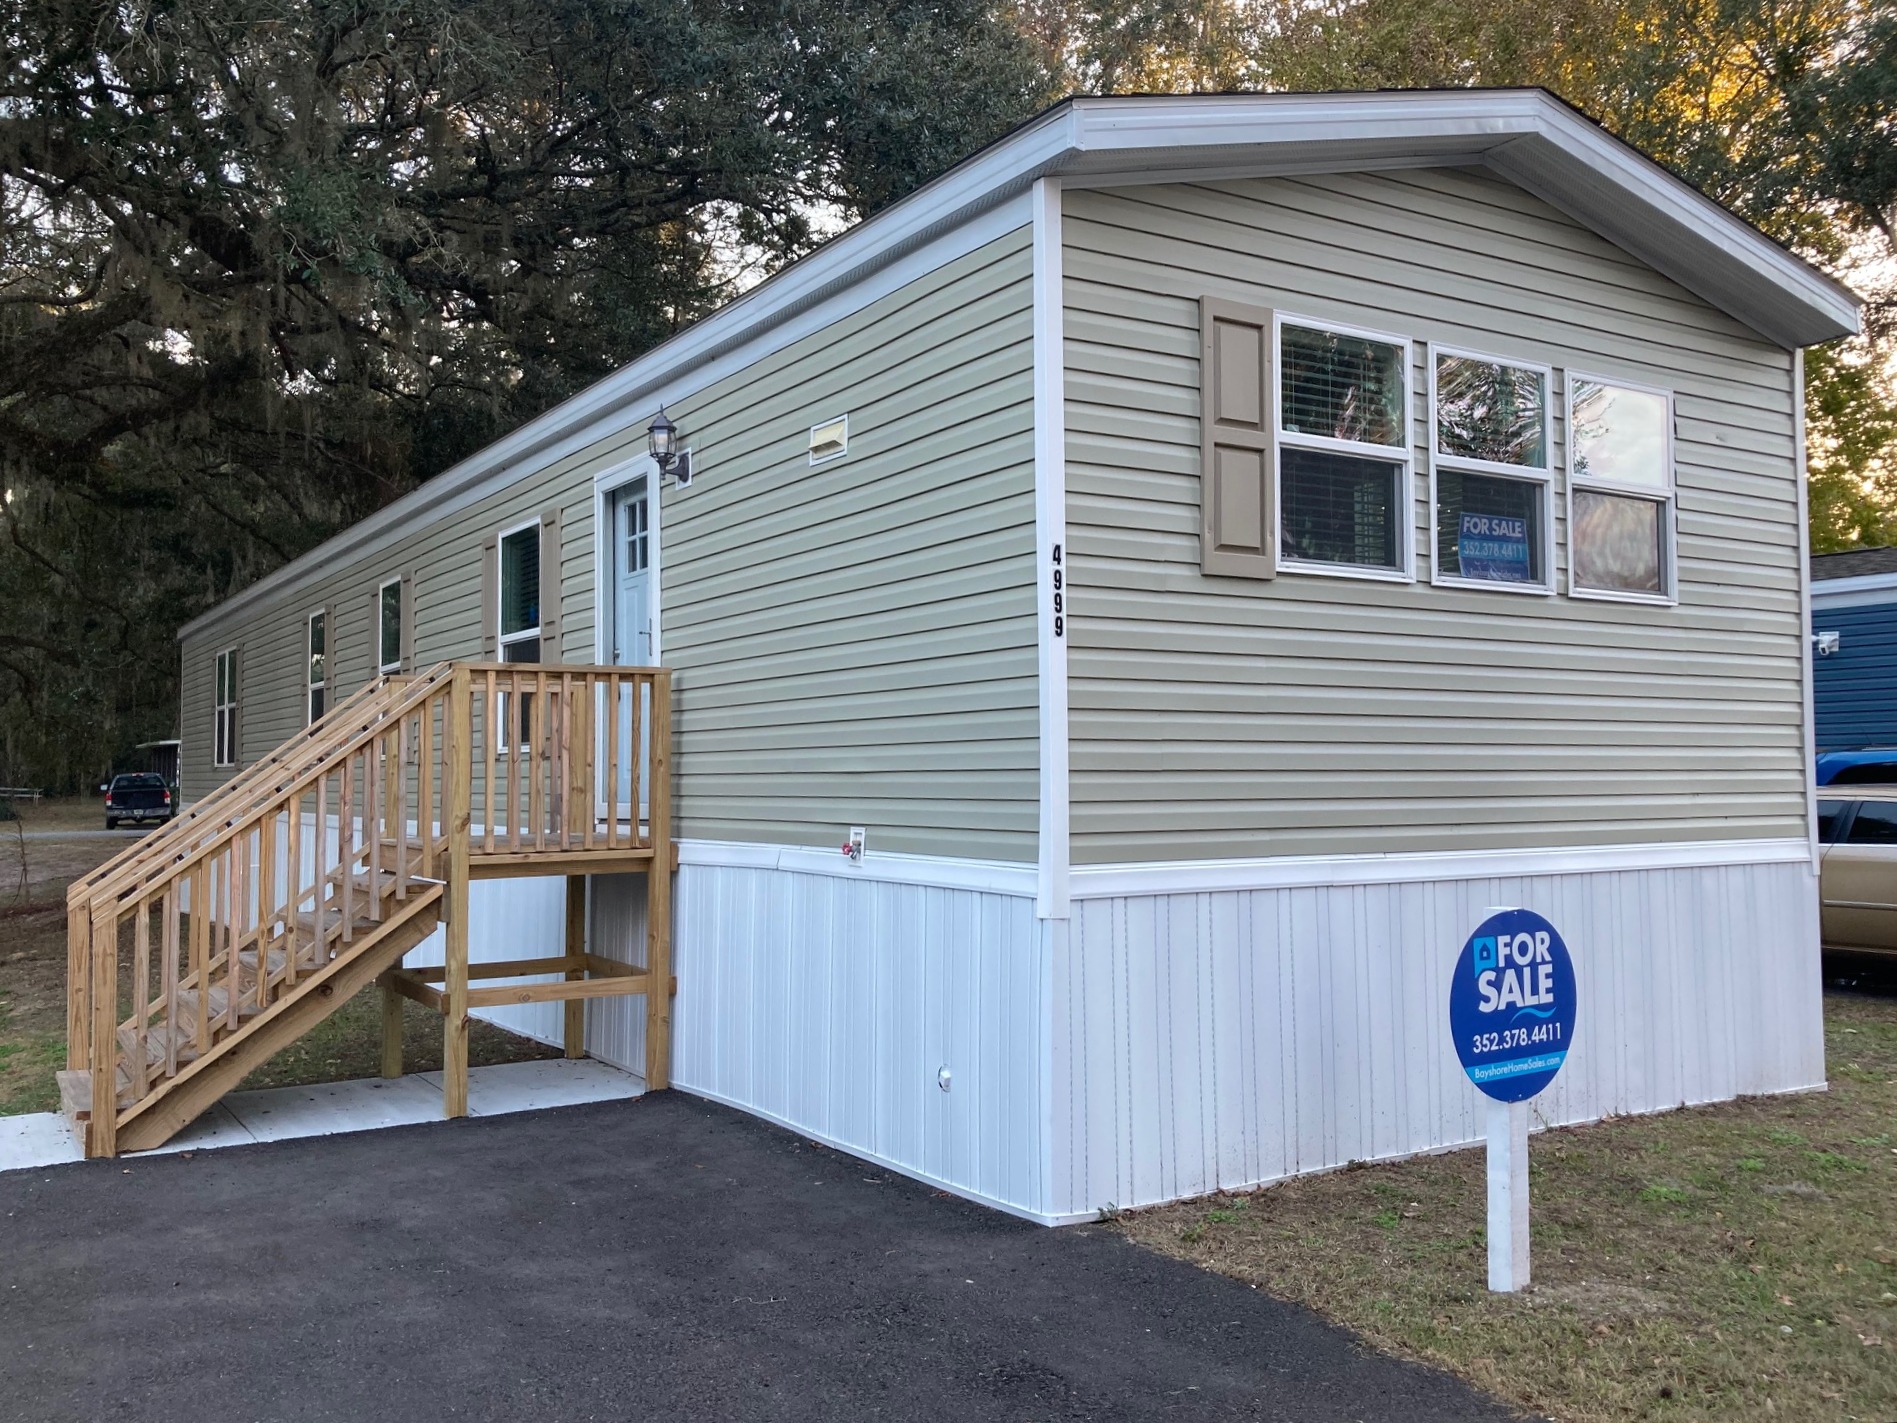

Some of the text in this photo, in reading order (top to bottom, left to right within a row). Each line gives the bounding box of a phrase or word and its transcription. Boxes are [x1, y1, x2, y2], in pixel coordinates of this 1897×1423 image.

[1463, 517, 1522, 537] FOR SALE
[1463, 541, 1523, 558] 352.378.4411
[1053, 544, 1063, 637] 4999
[1497, 931, 1552, 967] FOR
[1478, 964, 1554, 1013] SALE
[1473, 1022, 1561, 1053] 352.378.4411
[1474, 1057, 1560, 1079] BayshoreHomeSales.com
